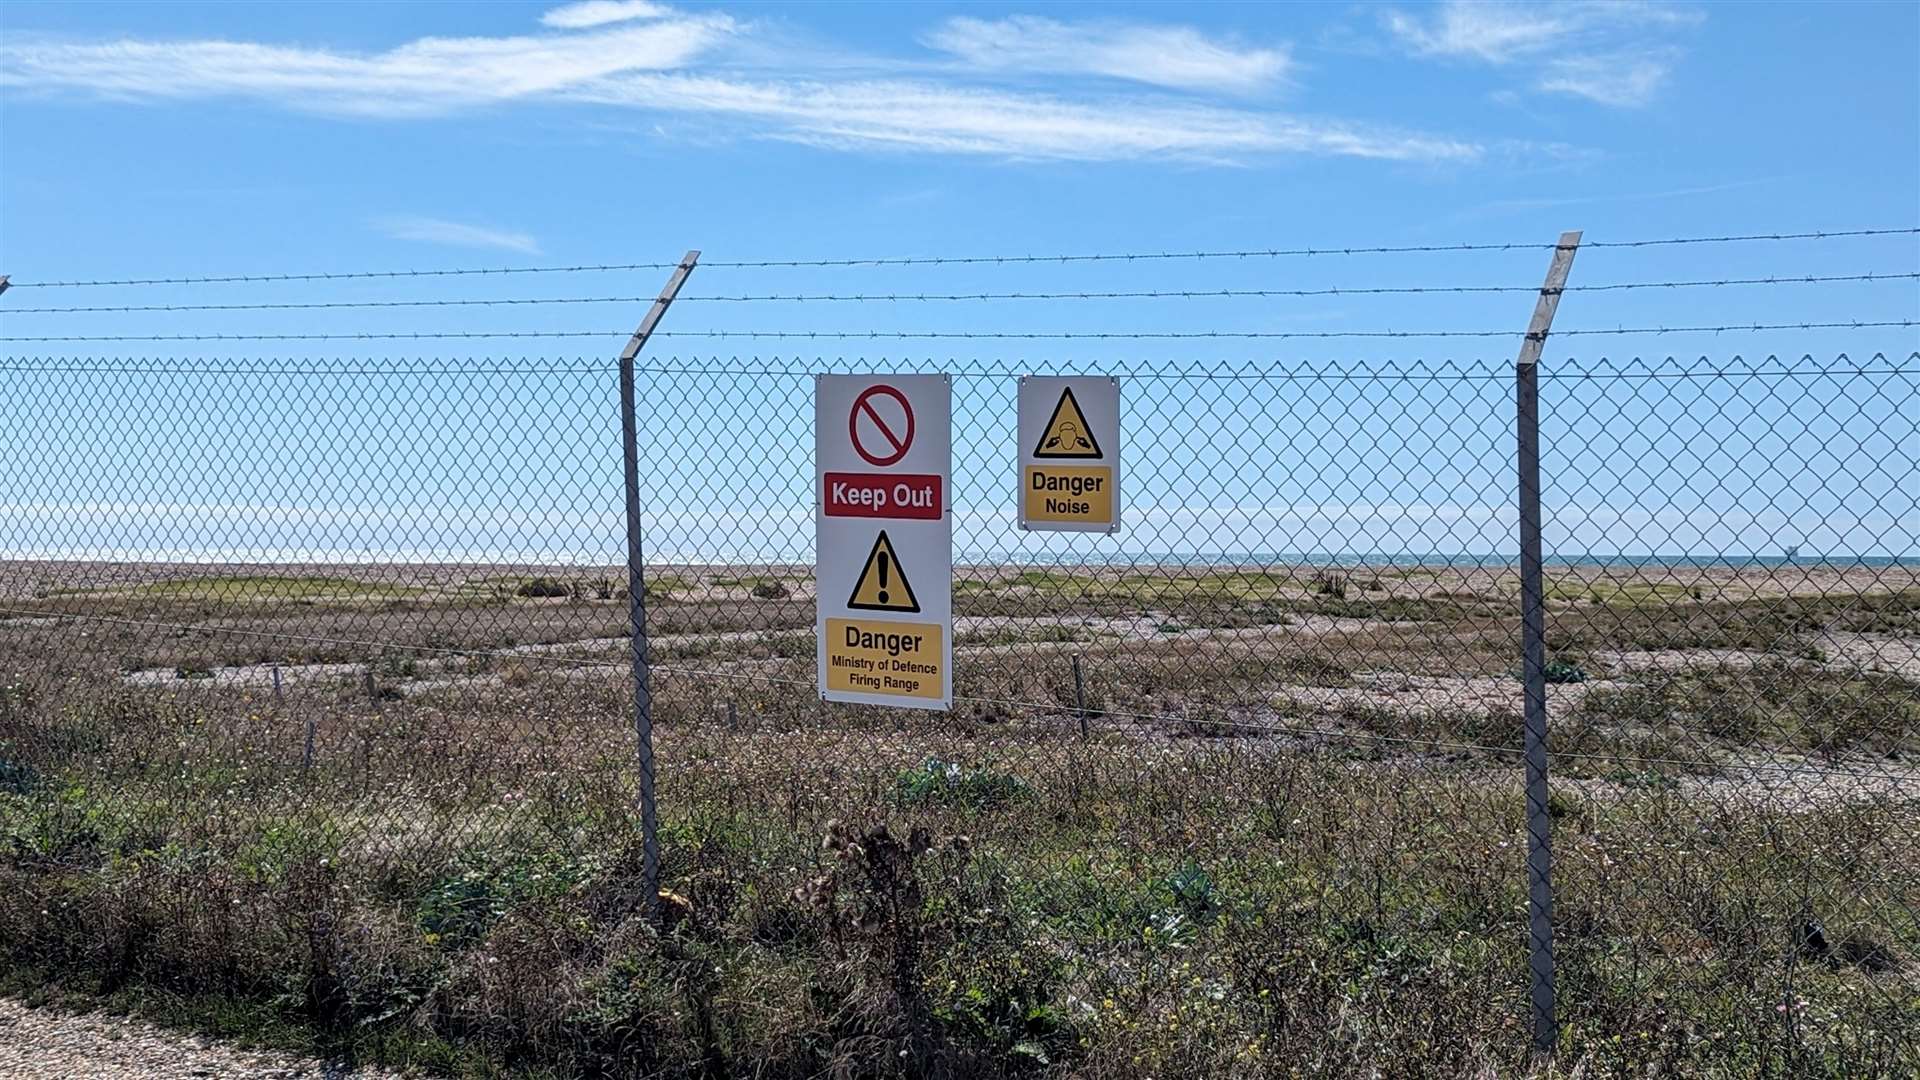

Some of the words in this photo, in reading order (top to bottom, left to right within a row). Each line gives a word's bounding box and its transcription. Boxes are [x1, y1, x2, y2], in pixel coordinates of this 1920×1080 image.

[1032, 472, 1103, 496] Danger
[832, 482, 887, 511] Keep
[893, 484, 933, 507] Out
[1046, 498, 1090, 514] Noise
[846, 626, 922, 656] Danger
[832, 655, 875, 672] Ministry
[878, 660, 889, 671] of
[892, 660, 937, 674] Defence
[850, 673, 880, 689] Firing
[884, 676, 919, 692] Range
